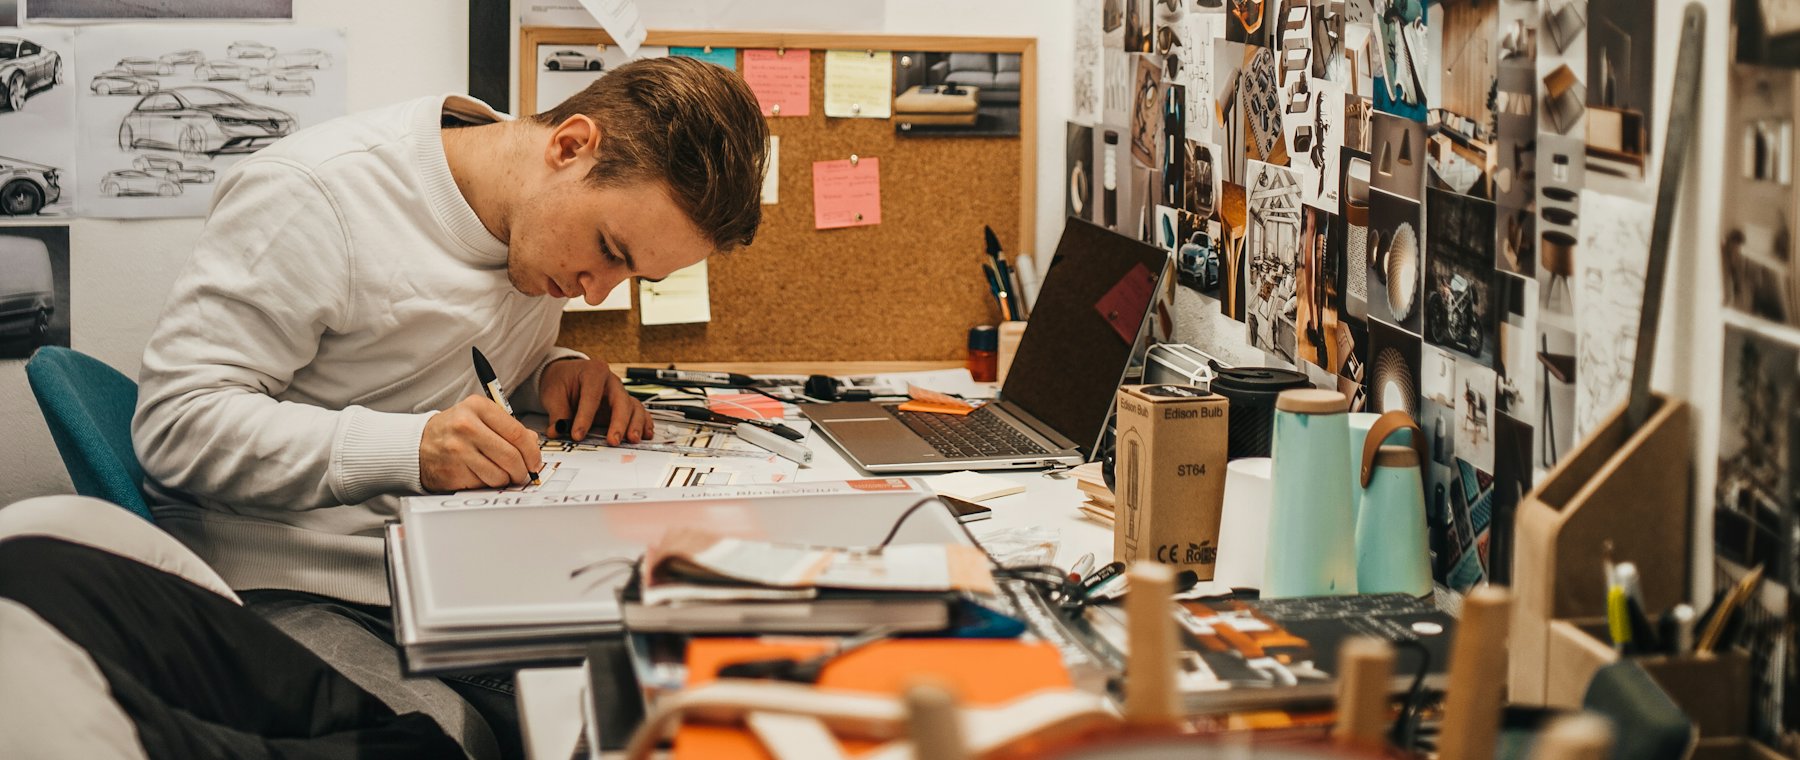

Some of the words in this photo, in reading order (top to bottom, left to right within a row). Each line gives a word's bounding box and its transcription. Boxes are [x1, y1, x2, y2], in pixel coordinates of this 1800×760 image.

[1120, 398, 1137, 412] Edison
[1137, 404, 1149, 418] Bulb
[1164, 408, 1198, 420] Edison
[1200, 407, 1223, 418] Bulb
[1177, 464, 1206, 477] ST64
[440, 496, 529, 508] CORE
[543, 491, 648, 504] SKILLS
[682, 490, 731, 498] Lukas
